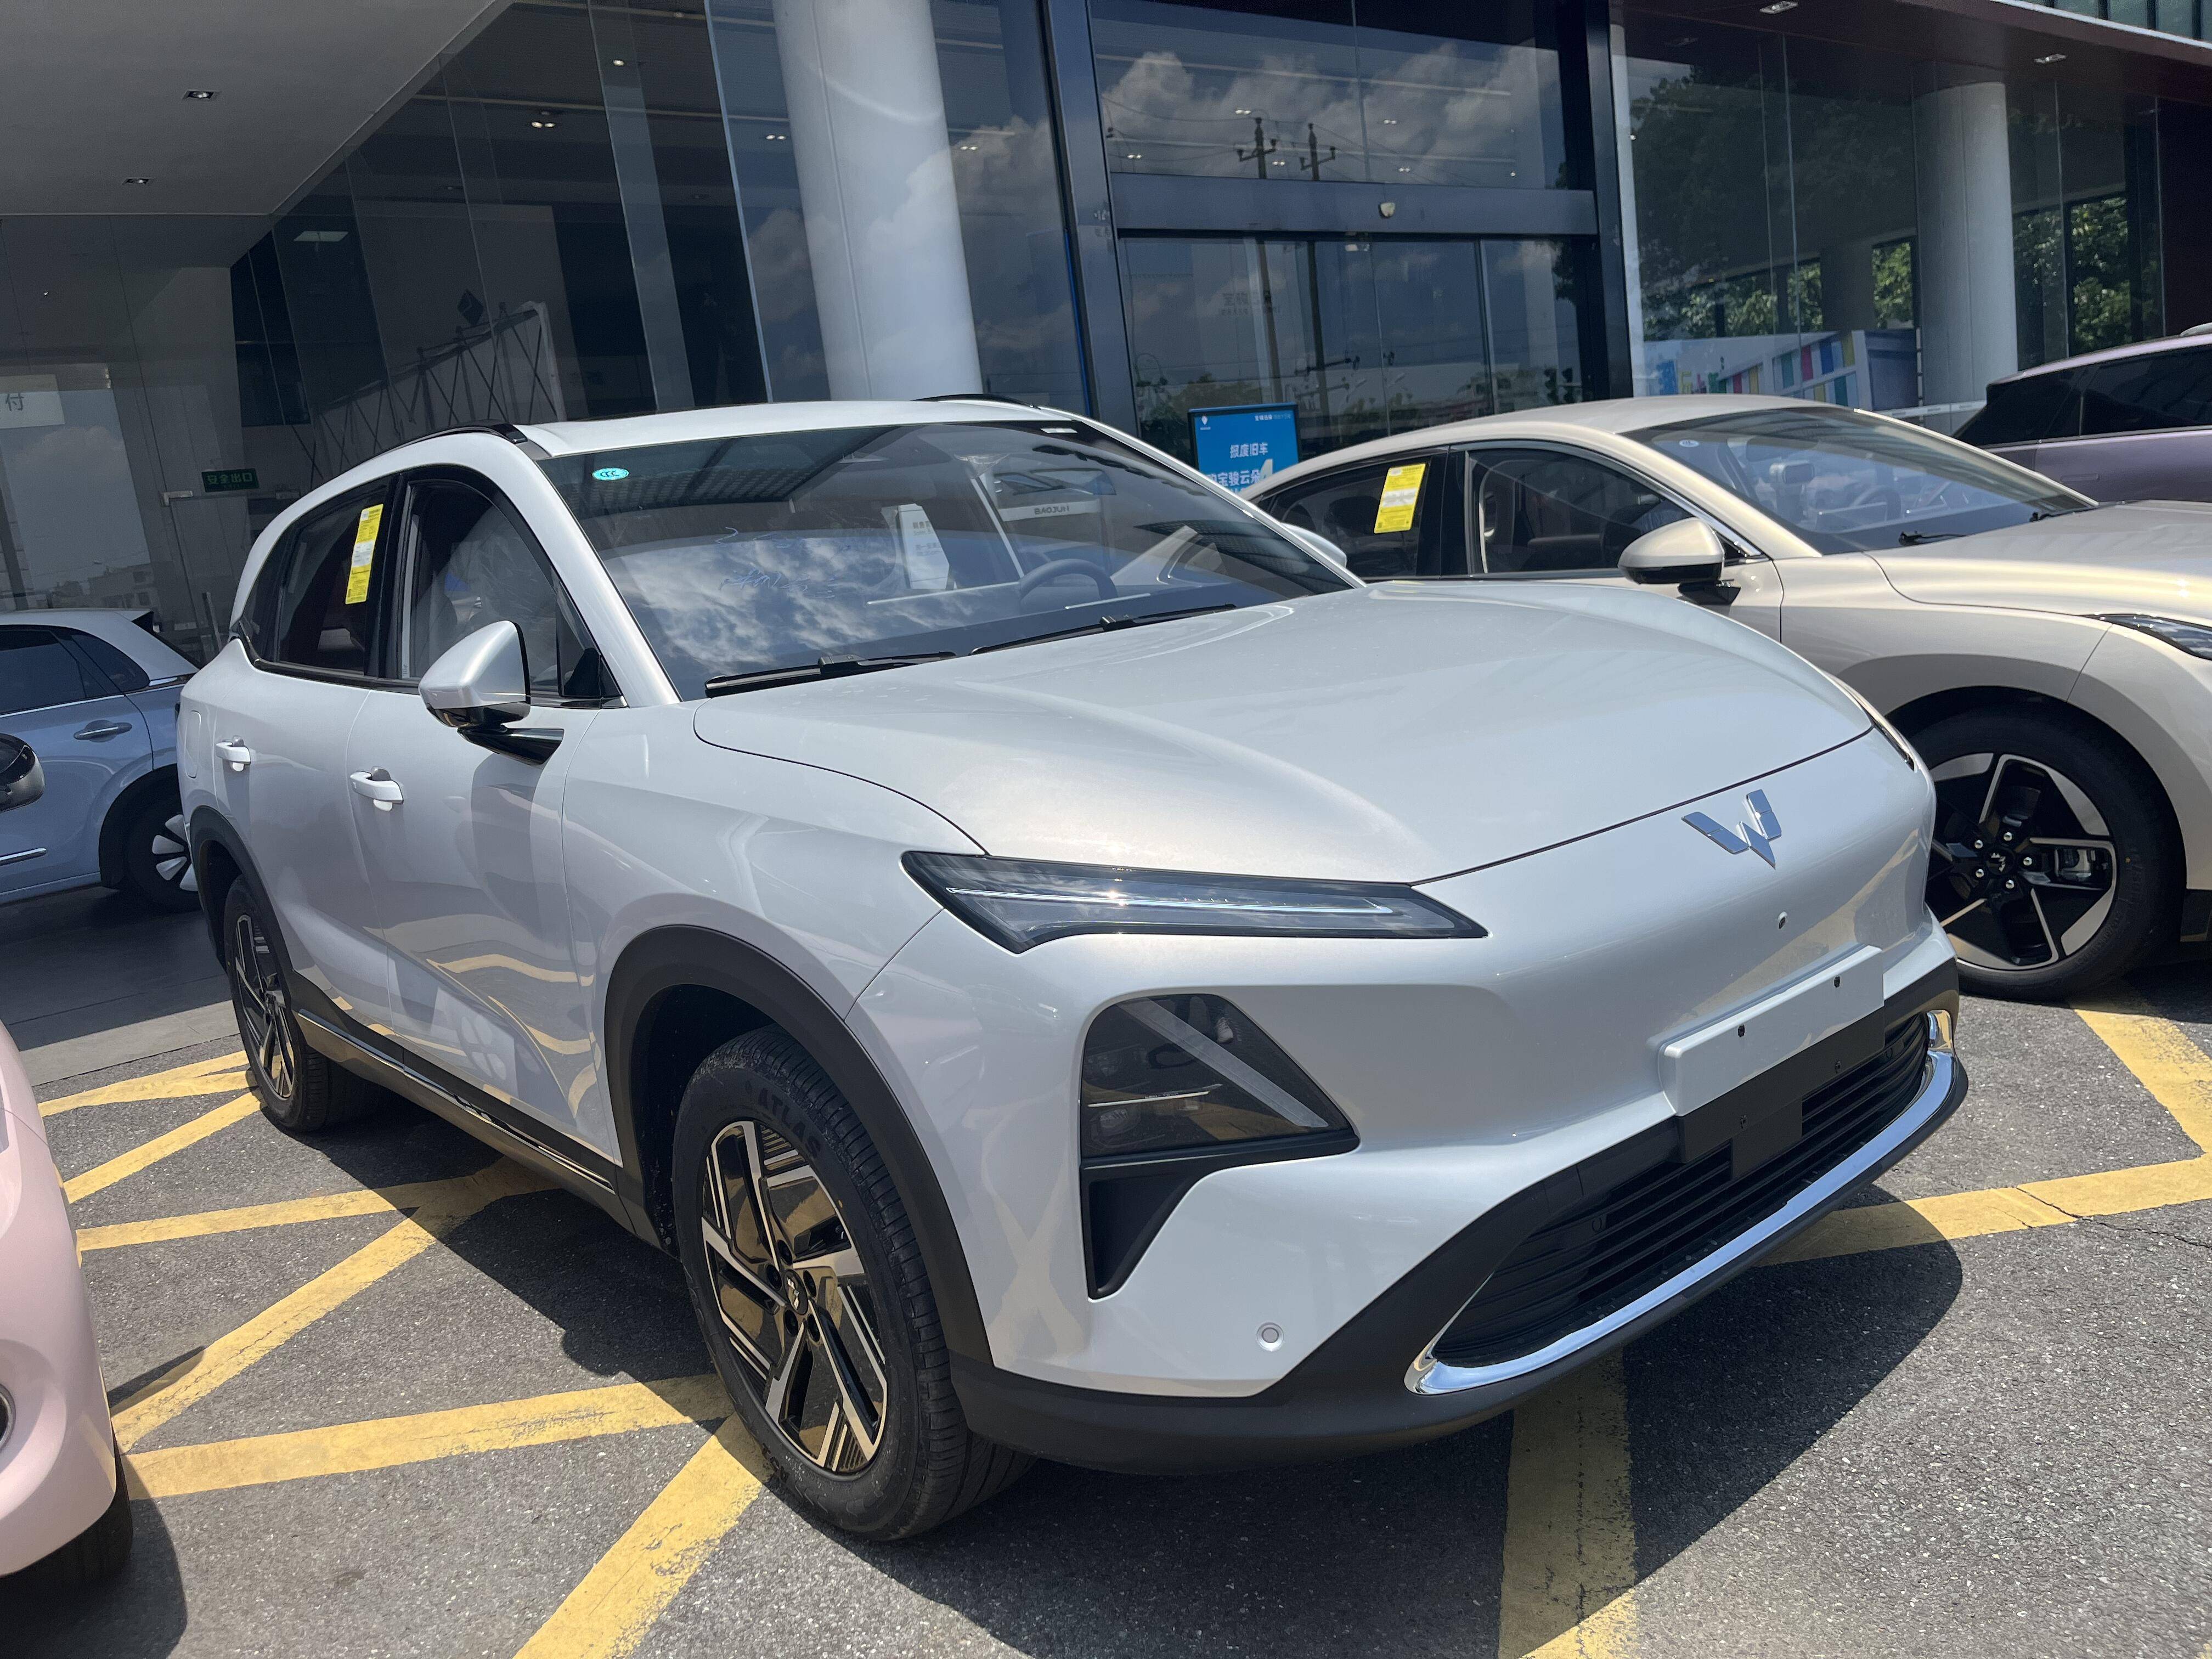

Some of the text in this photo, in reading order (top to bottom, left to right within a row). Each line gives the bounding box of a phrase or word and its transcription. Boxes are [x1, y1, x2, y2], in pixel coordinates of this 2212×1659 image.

[5, 393, 25, 411] 付
[207, 473, 252, 485] 安全出口
[1034, 505, 1070, 515] BAOJUN
[758, 1087, 822, 1159] ATLAS
